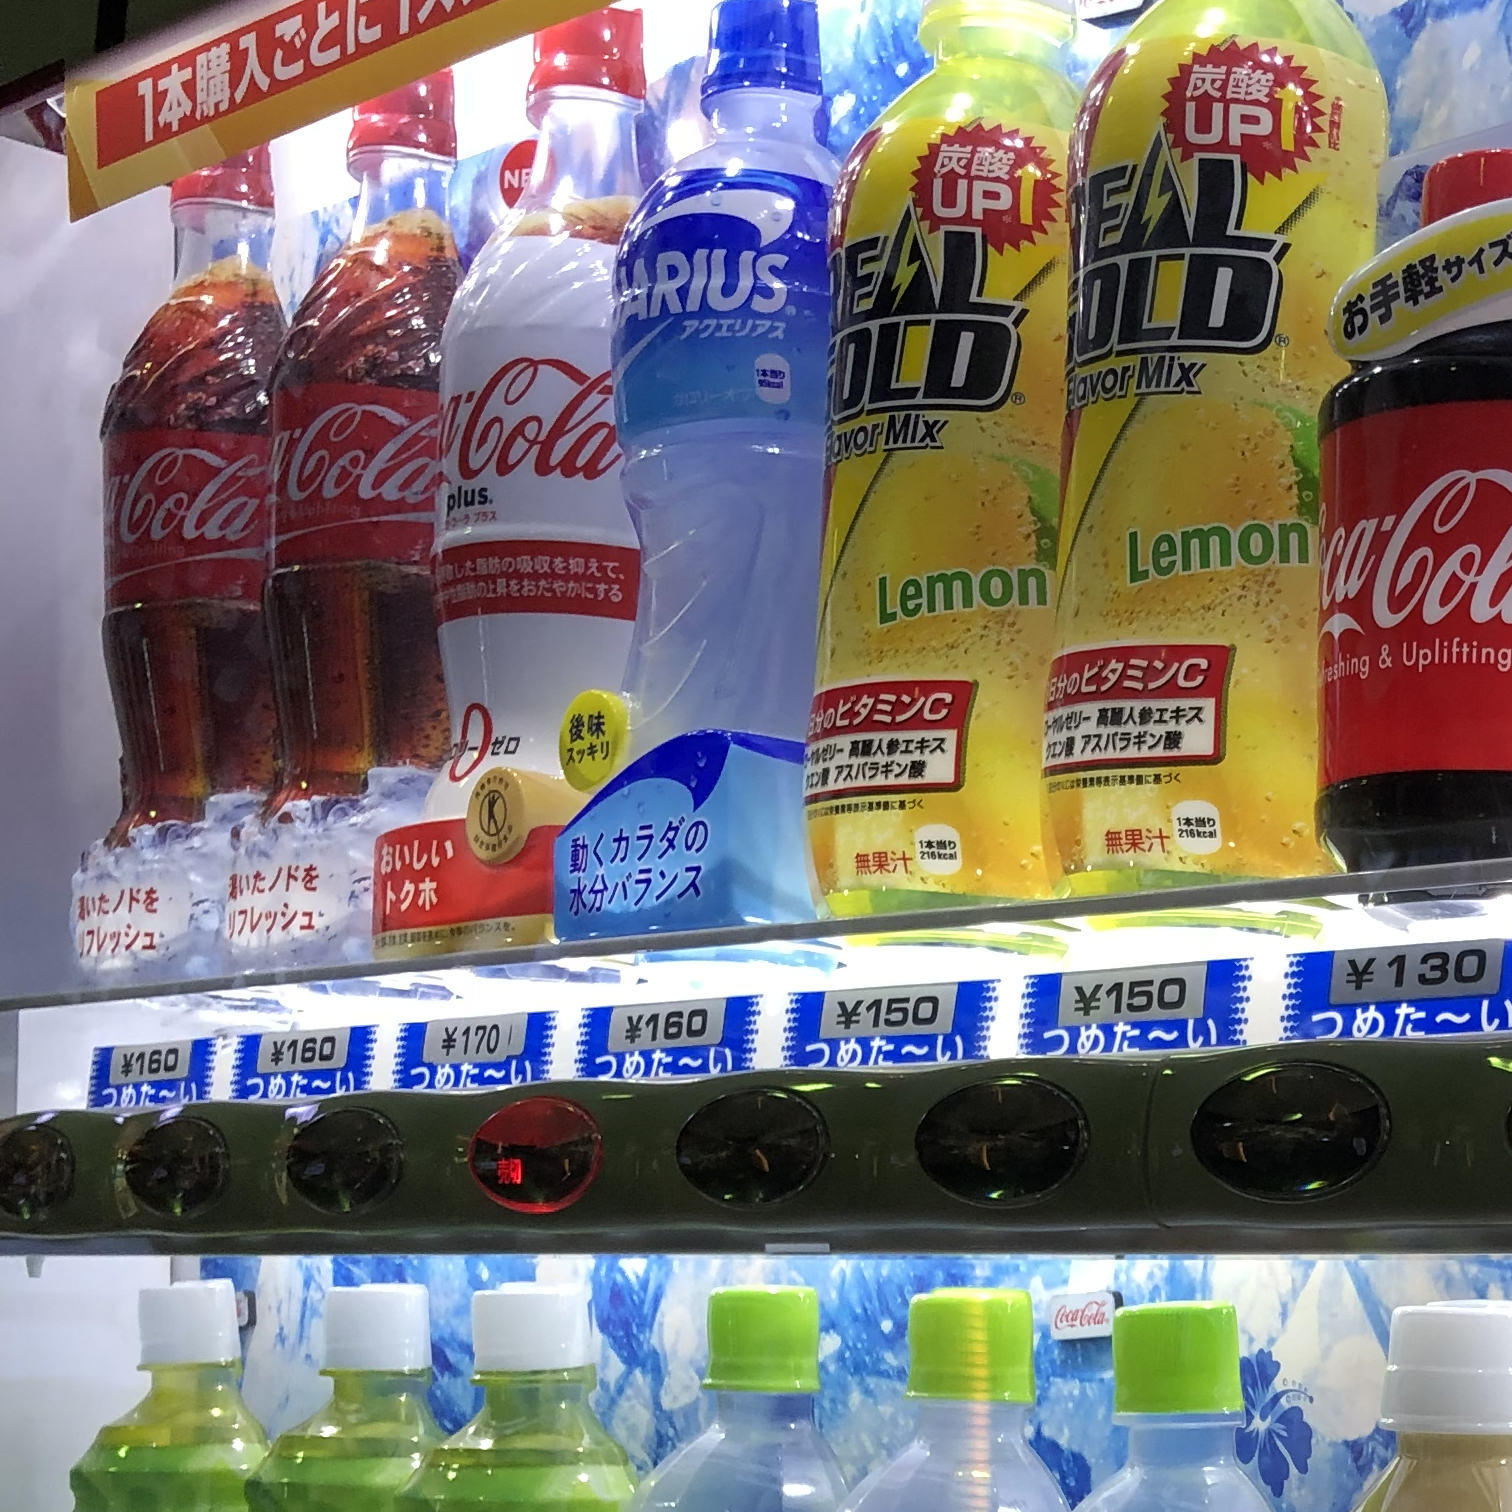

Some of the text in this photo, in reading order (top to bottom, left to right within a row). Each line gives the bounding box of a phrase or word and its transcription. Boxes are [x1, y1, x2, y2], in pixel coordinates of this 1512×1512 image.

[1186, 64, 1273, 103] 炭酸
[934, 143, 1014, 181] 炭酸
[680, 318, 787, 340] アクエリアス
[1135, 355, 1207, 395] Mix
[884, 413, 949, 452] Mix
[1126, 520, 1313, 585] Lemon
[877, 563, 1052, 627] Lemon
[1378, 637, 1512, 673] & Uplifting
[568, 711, 606, 740] 後味
[1096, 705, 1204, 728] 高麗人参エキス
[565, 739, 610, 767] スッキリ
[1080, 730, 1183, 756] アスパラギン酸
[834, 760, 928, 783] アスパラギン酸
[1176, 817, 1216, 828] 1本当り
[1177, 828, 1217, 839] 216kcal
[380, 837, 453, 874] おいしい
[568, 817, 709, 874] 動くカラダの
[918, 840, 957, 850] 1本当り
[1104, 828, 1171, 854] 無果汁
[853, 851, 913, 875] 無果汁
[385, 877, 438, 915] トクホ
[568, 865, 702, 917] 水分バランス
[229, 903, 316, 940] リフレッシュ
[1345, 947, 1487, 991] ¥130
[836, 995, 940, 1030] ¥150
[1075, 976, 1187, 1017] ¥150
[441, 1026, 500, 1057] ¥170
[624, 1008, 708, 1044] ¥160
[121, 1047, 179, 1077] ¥160
[270, 1034, 337, 1066] ¥160
[1054, 1299, 1108, 1331] Coca-Cola
